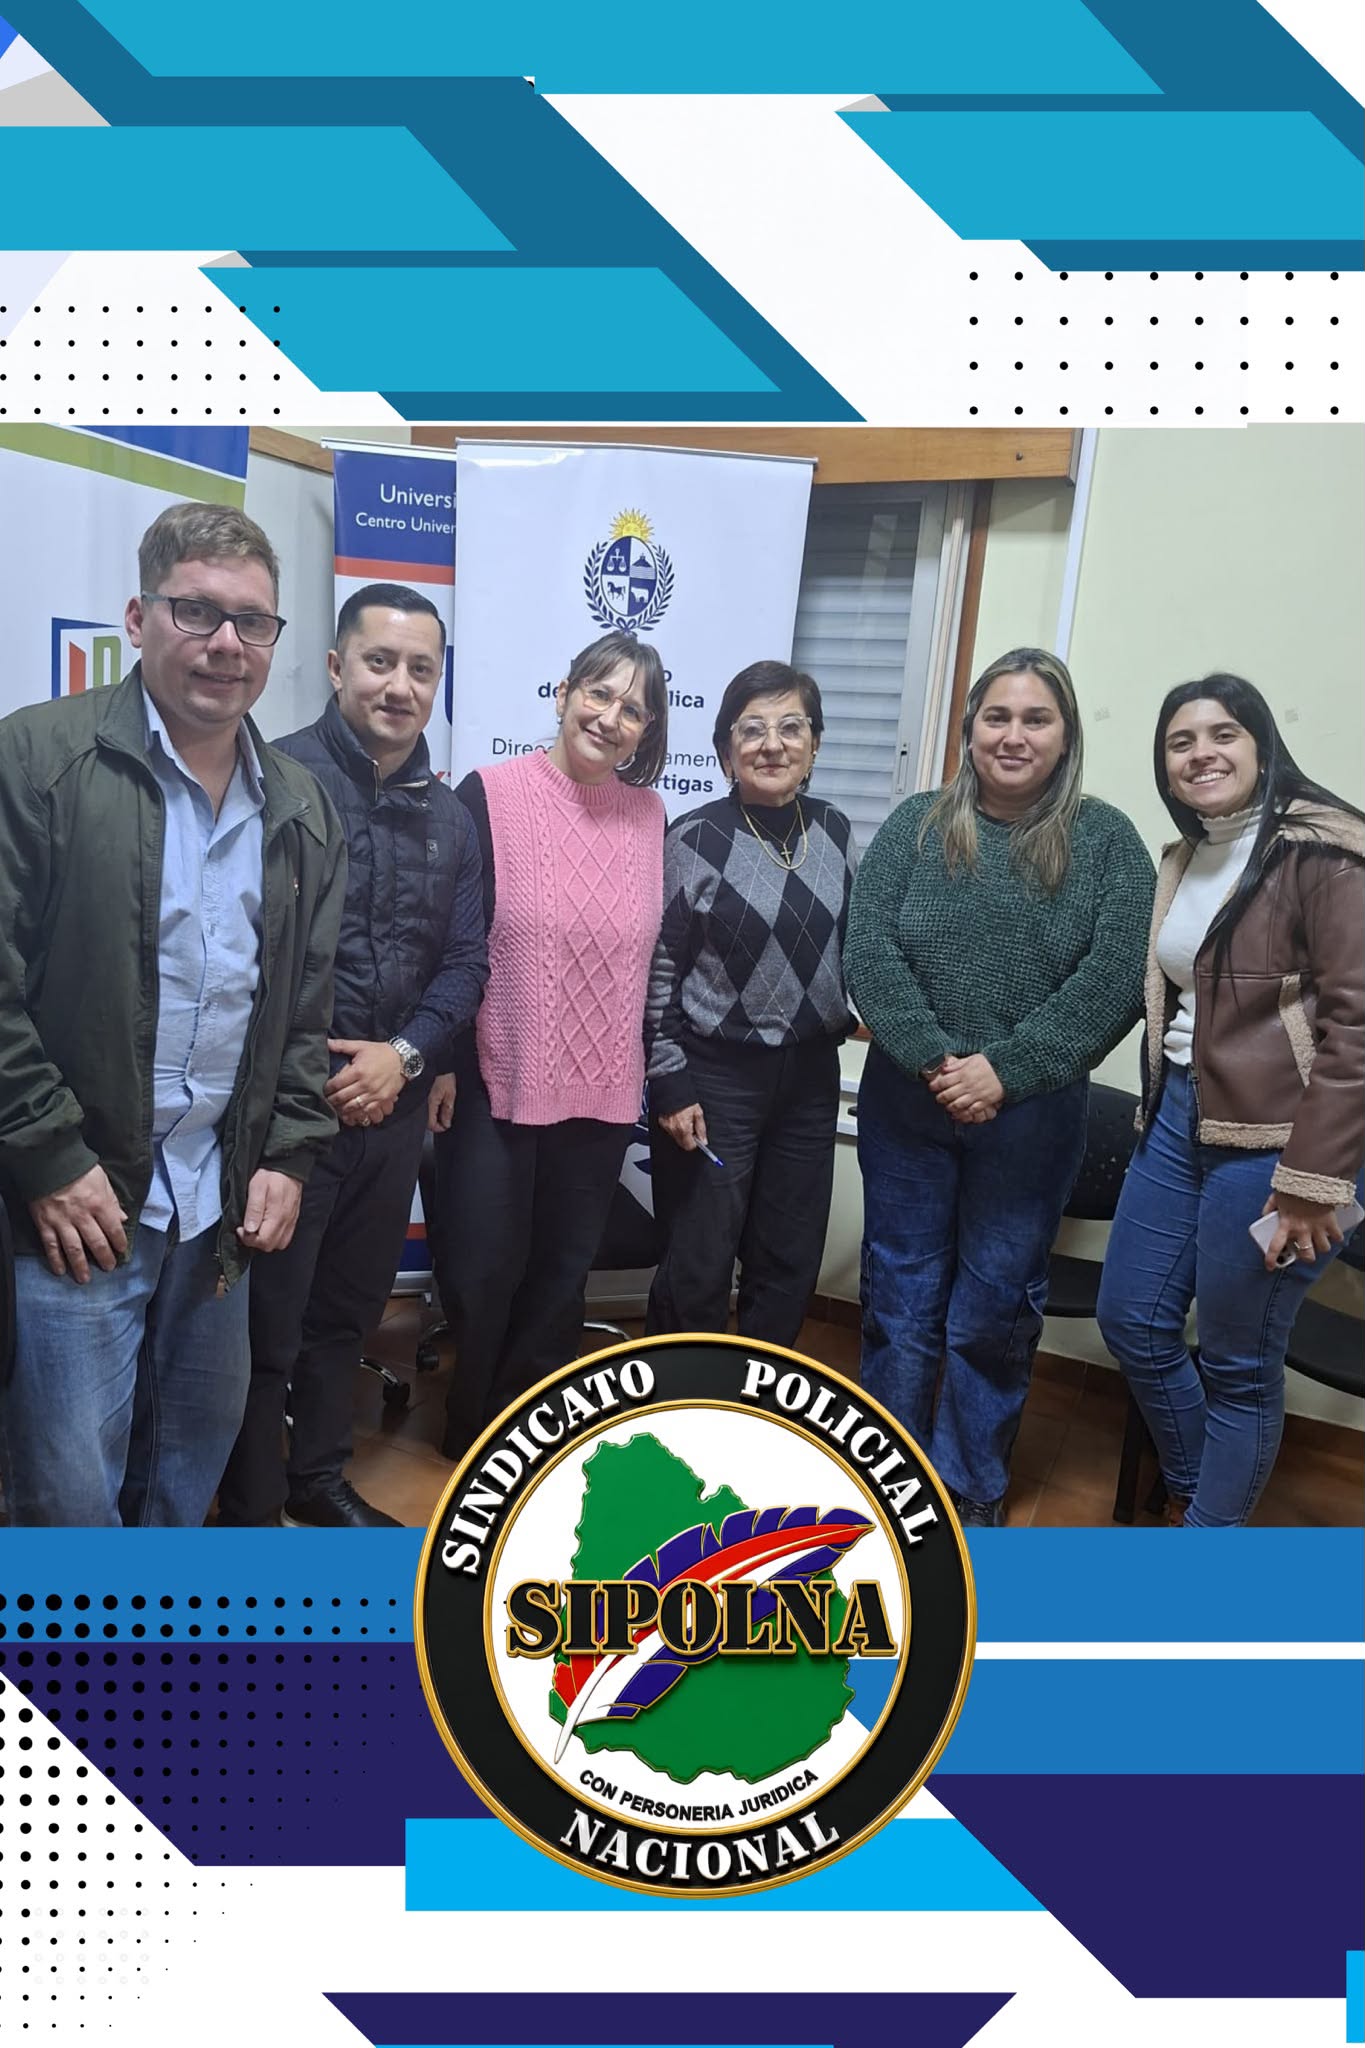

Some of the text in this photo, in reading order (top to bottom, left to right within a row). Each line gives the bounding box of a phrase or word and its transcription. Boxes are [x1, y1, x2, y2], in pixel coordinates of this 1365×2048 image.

[380, 483, 456, 509] Universi
[355, 511, 456, 534] Centro Univer
[669, 690, 705, 708] lica
[650, 773, 713, 795] rtigas
